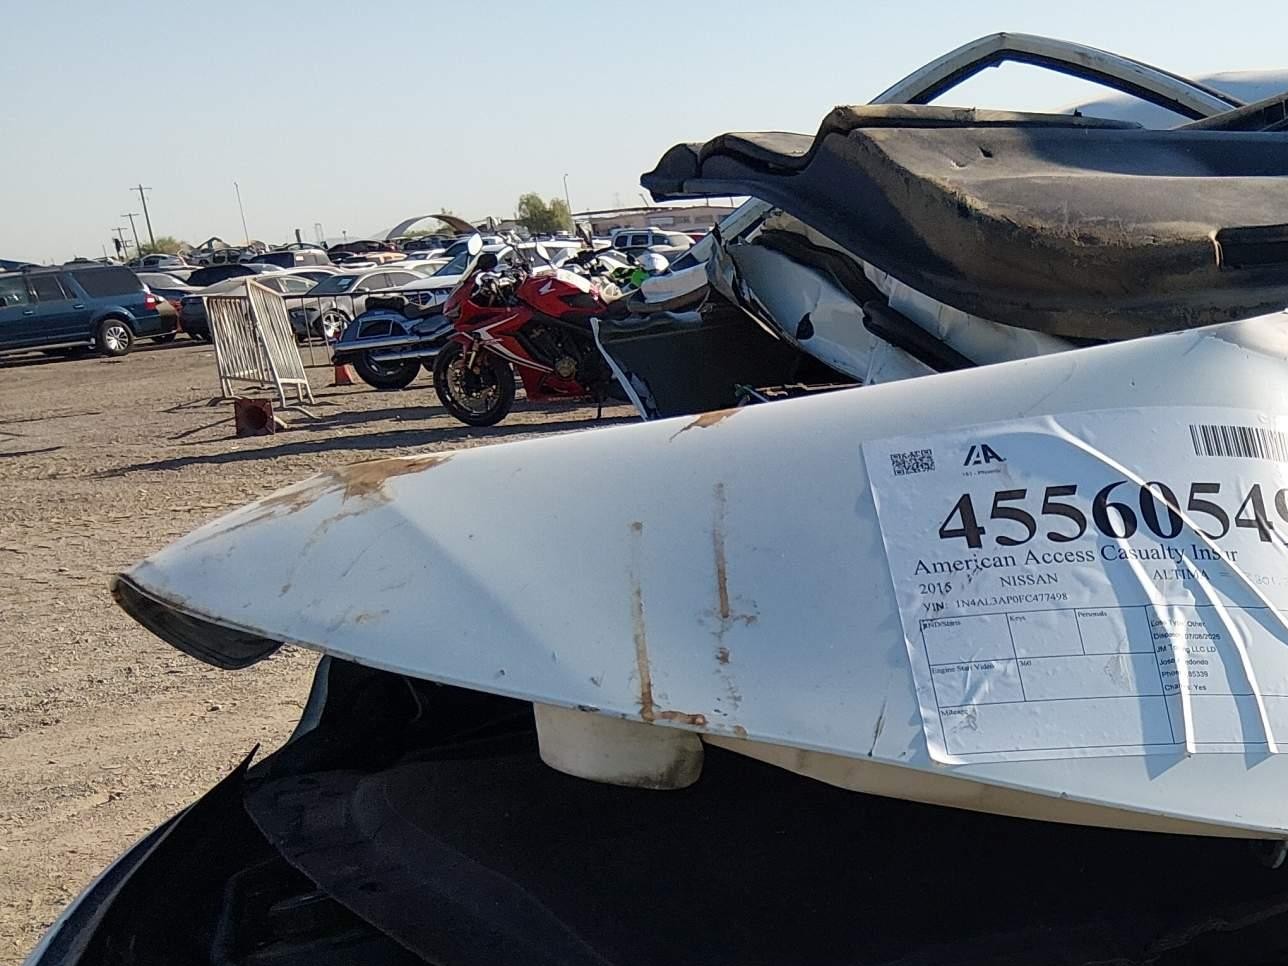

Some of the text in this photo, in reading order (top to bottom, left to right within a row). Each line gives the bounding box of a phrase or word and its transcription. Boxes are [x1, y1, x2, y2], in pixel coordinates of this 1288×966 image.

[914, 553, 1017, 575] American
[1025, 550, 1096, 566] Access
[1101, 543, 1185, 565] Casualty
[1000, 573, 1059, 587] NISSAN
[1153, 569, 1211, 581] ALTIMA
